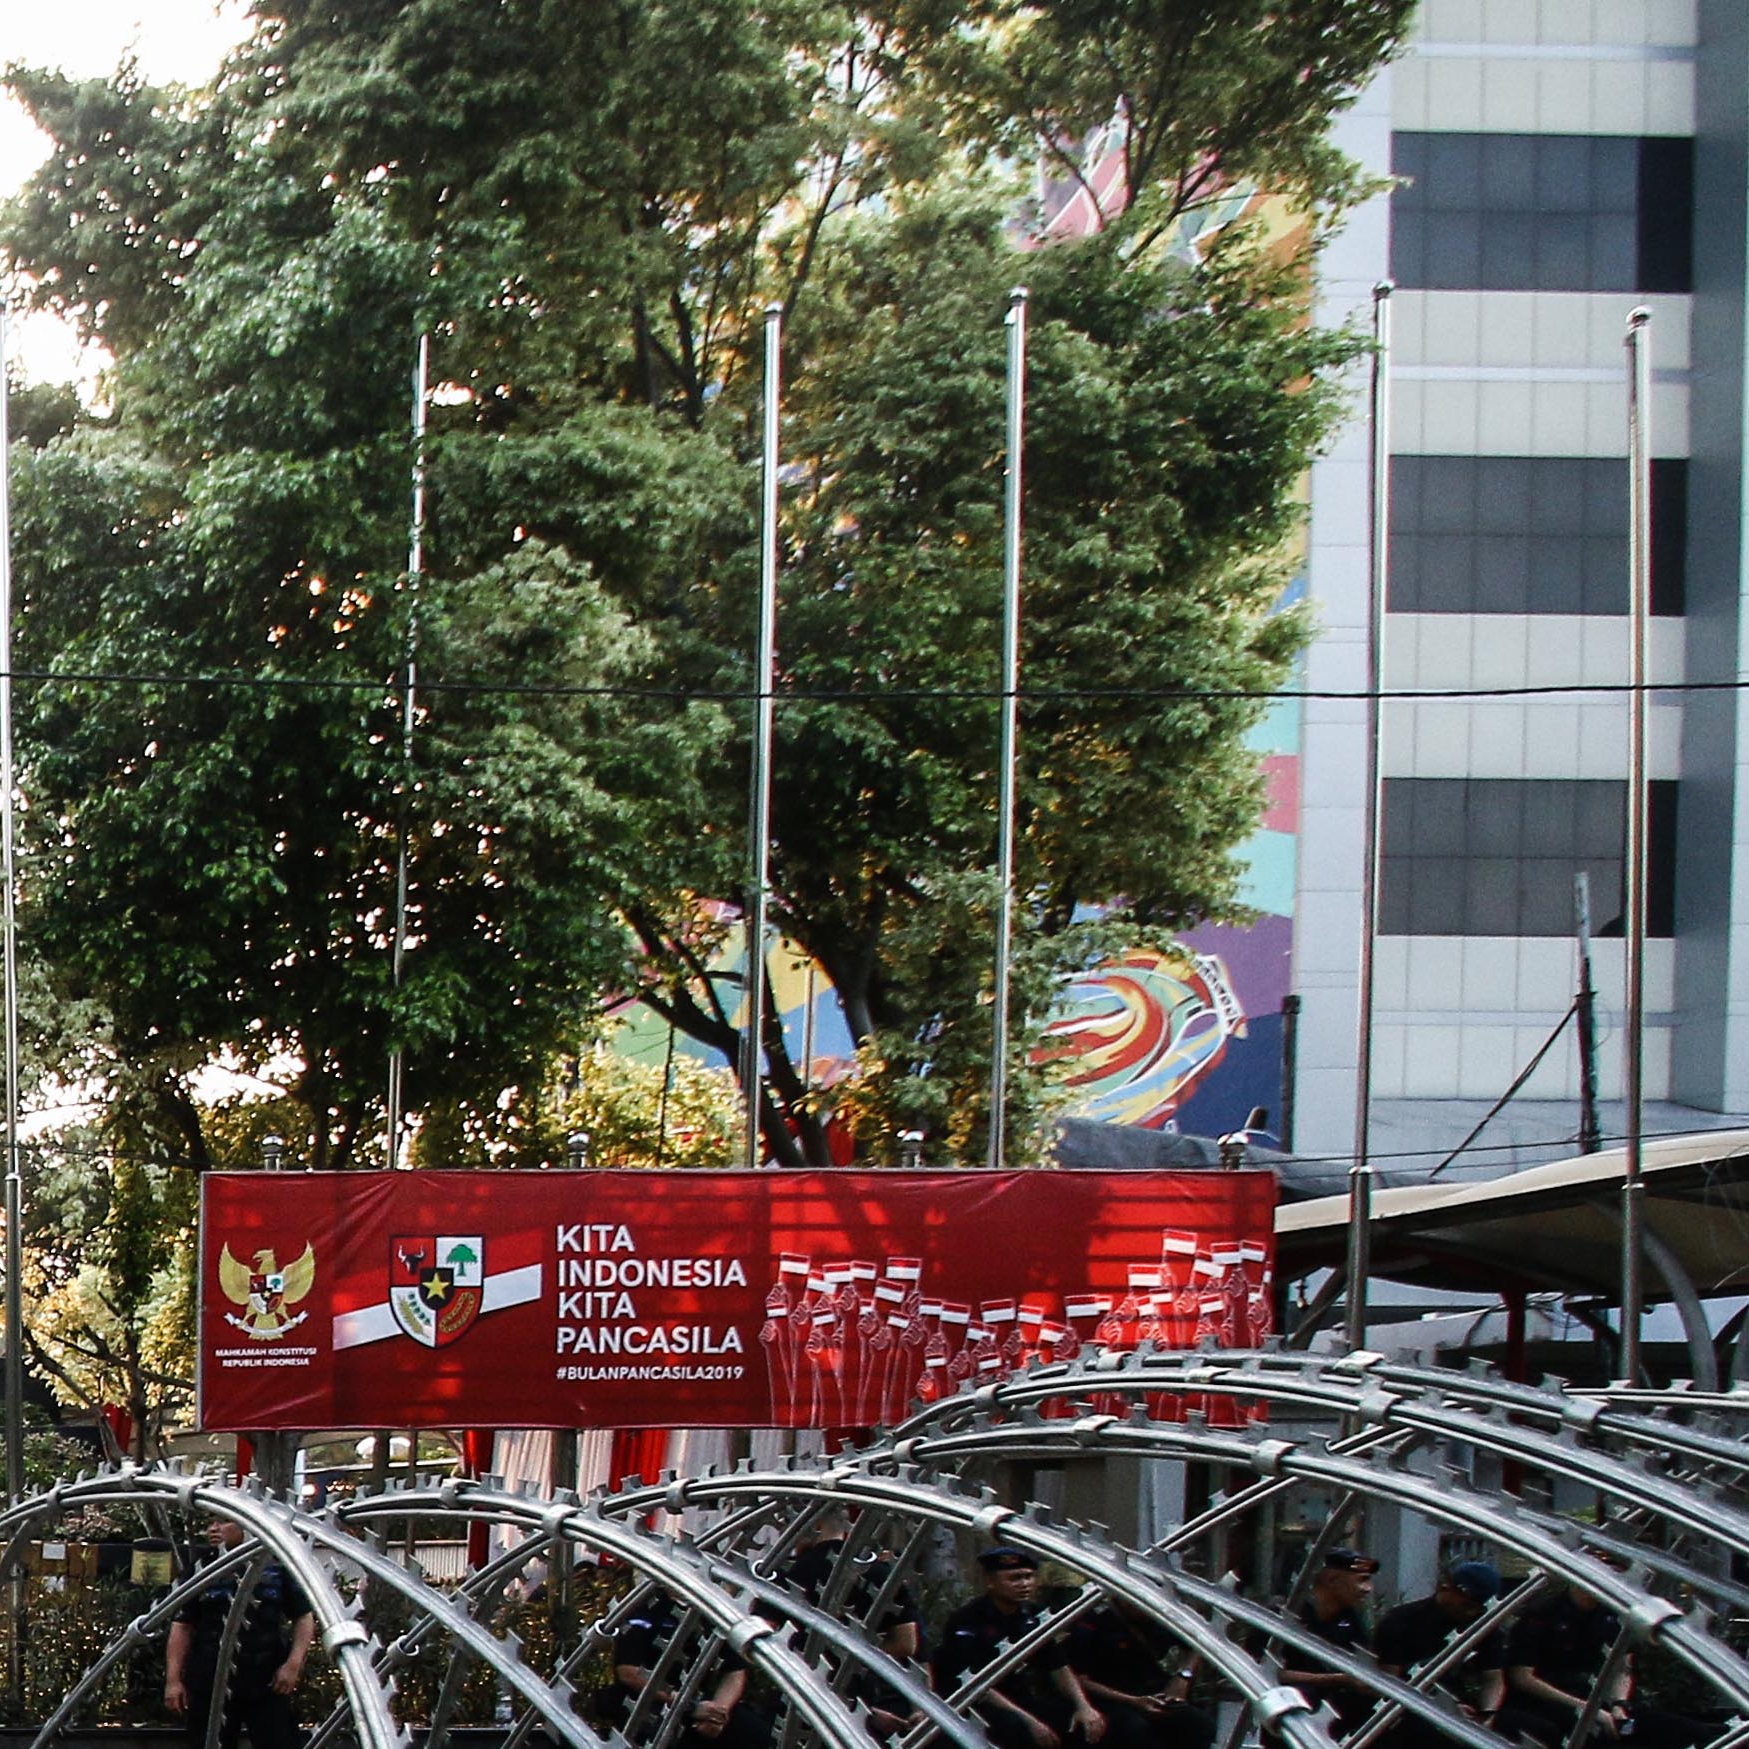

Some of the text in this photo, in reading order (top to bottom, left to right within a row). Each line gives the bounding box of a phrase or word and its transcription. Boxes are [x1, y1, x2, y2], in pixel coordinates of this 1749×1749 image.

[556, 1224, 636, 1252] KITA
[558, 1258, 748, 1288] INDONESIA
[558, 1291, 637, 1319] KITA
[214, 1347, 317, 1357] MAHKAMAH KONSTITUSI
[556, 1325, 744, 1354] PANCASILA
[222, 1357, 310, 1367] REPUBLIK INDONESIA
[556, 1366, 744, 1380] #BULANPANCASILA2019
